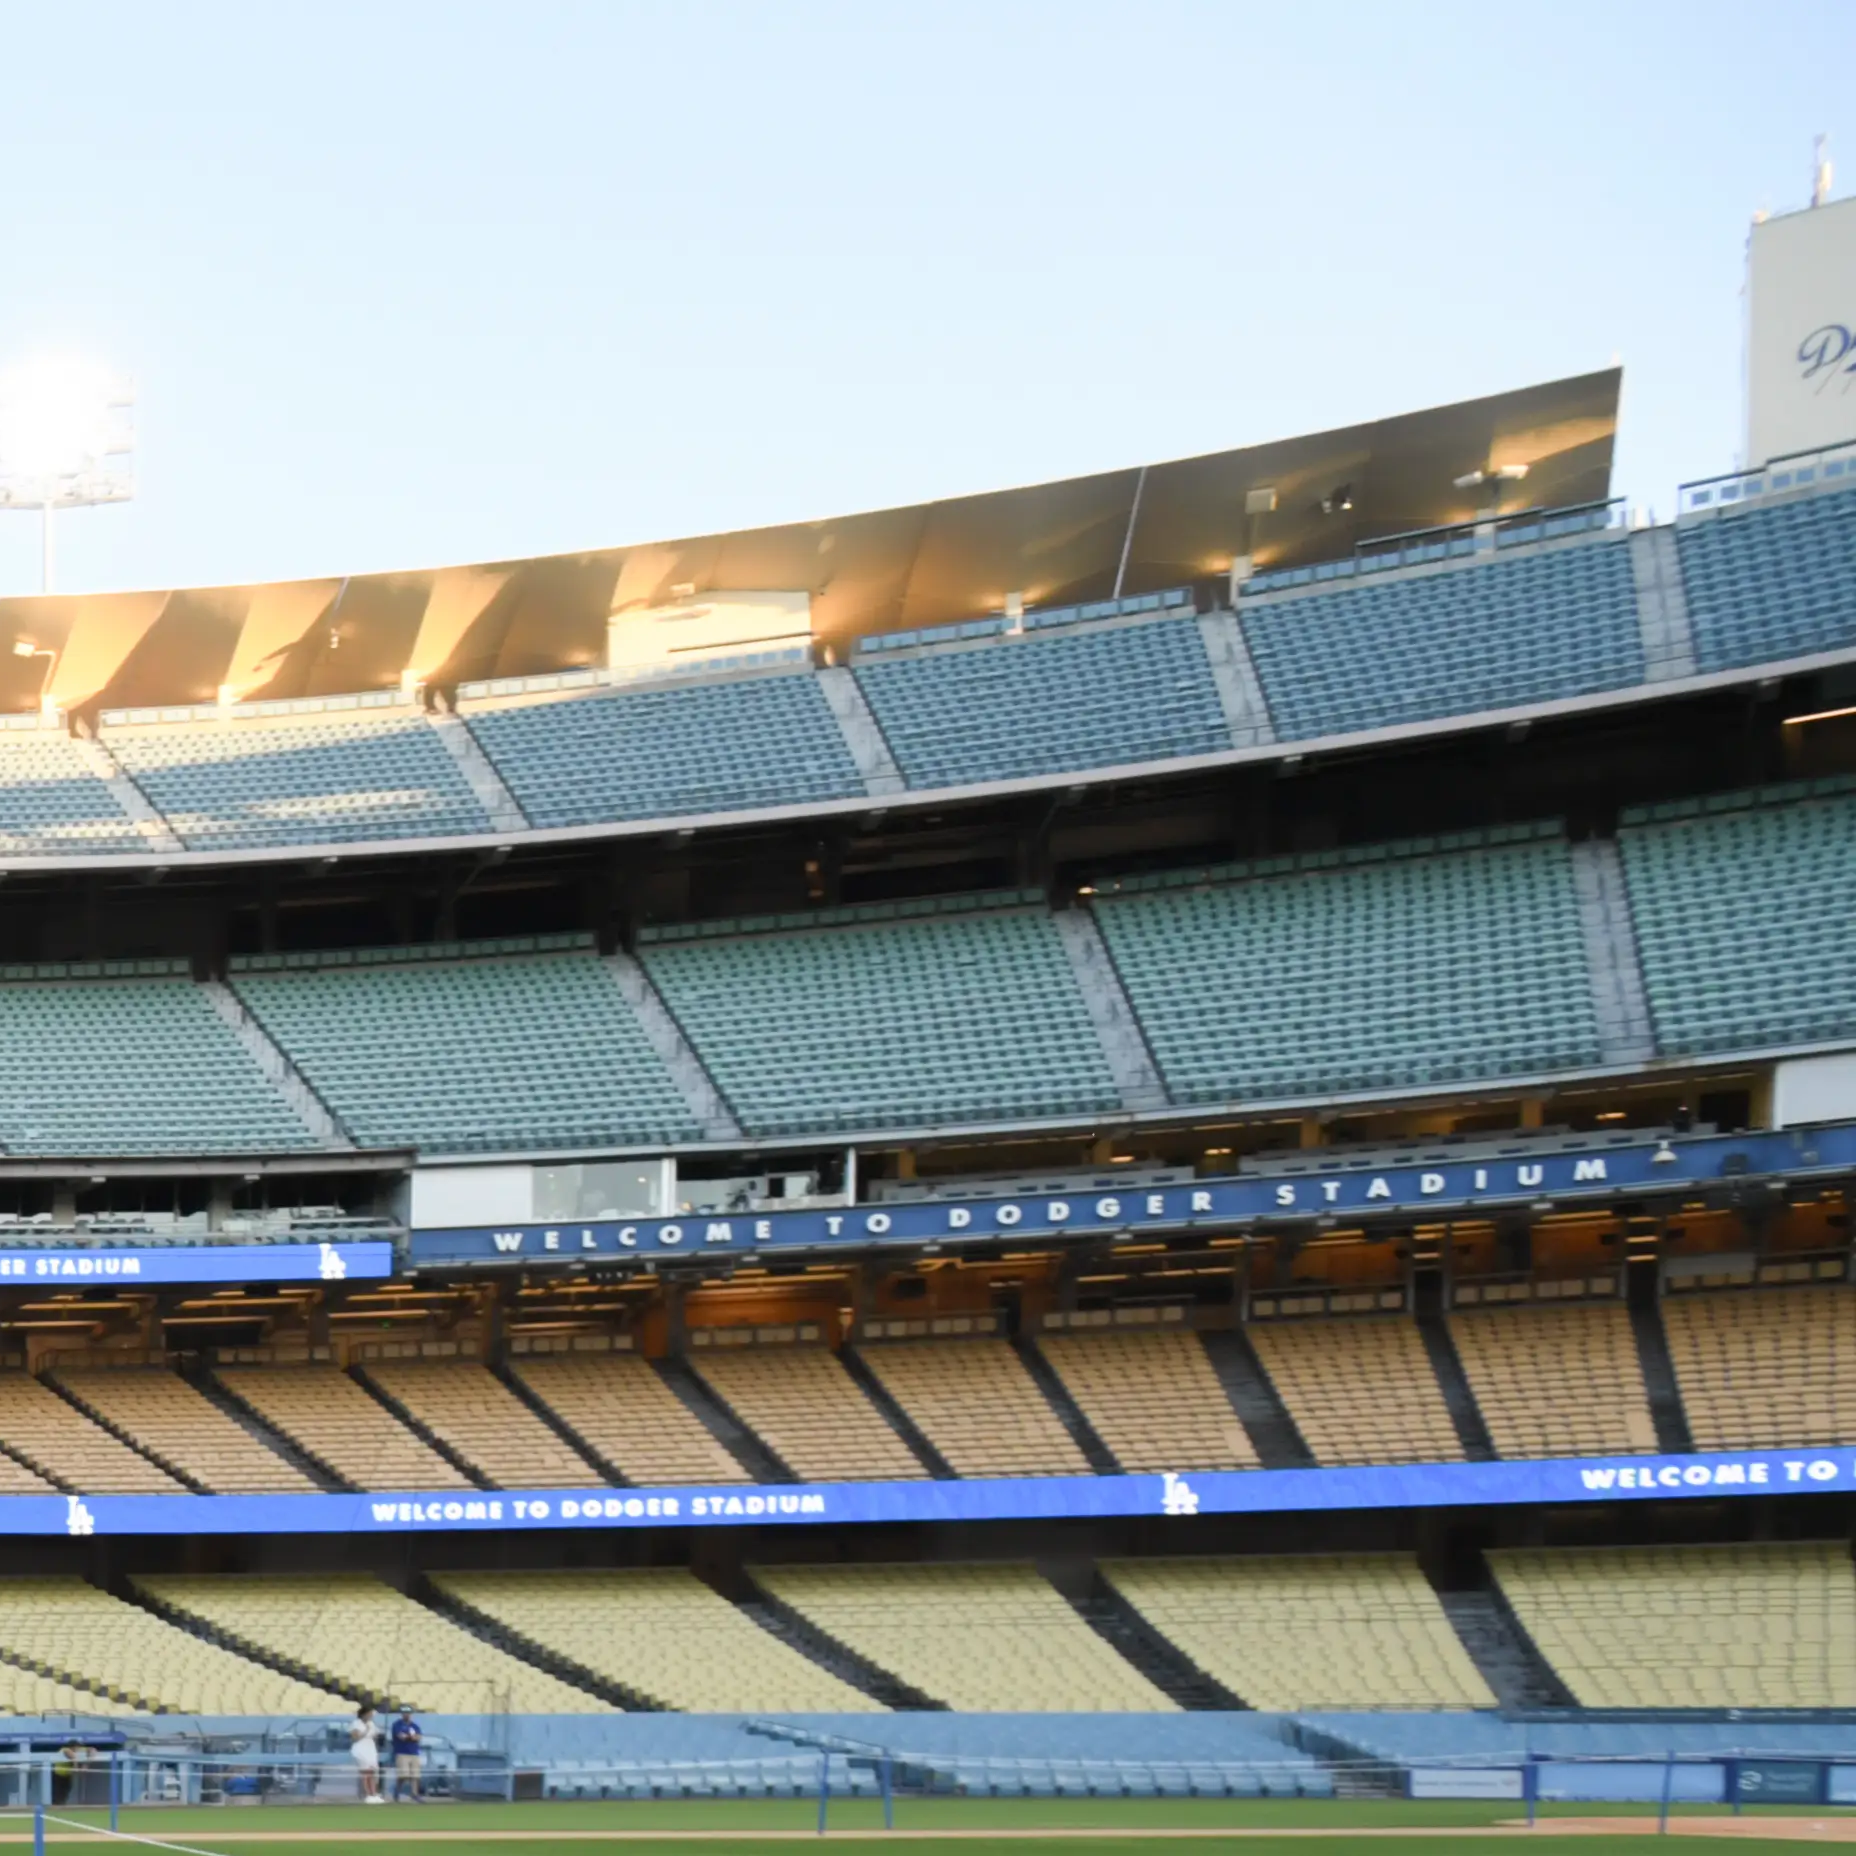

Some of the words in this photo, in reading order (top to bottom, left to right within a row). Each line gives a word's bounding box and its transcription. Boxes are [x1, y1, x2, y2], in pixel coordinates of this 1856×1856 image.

[492, 1219, 771, 1253] WELCOME
[826, 1209, 892, 1234] TO
[949, 1191, 1212, 1228] DODGER
[1276, 1159, 1607, 1206] STADIUM
[35, 1257, 141, 1276] STADIUM
[1581, 1462, 1768, 1490] WELCOME
[1784, 1460, 1838, 1481] TO
[372, 1501, 503, 1522] WELCOME
[513, 1500, 550, 1519] TO
[561, 1497, 680, 1518] DODGER
[691, 1494, 825, 1516] STADIUM
